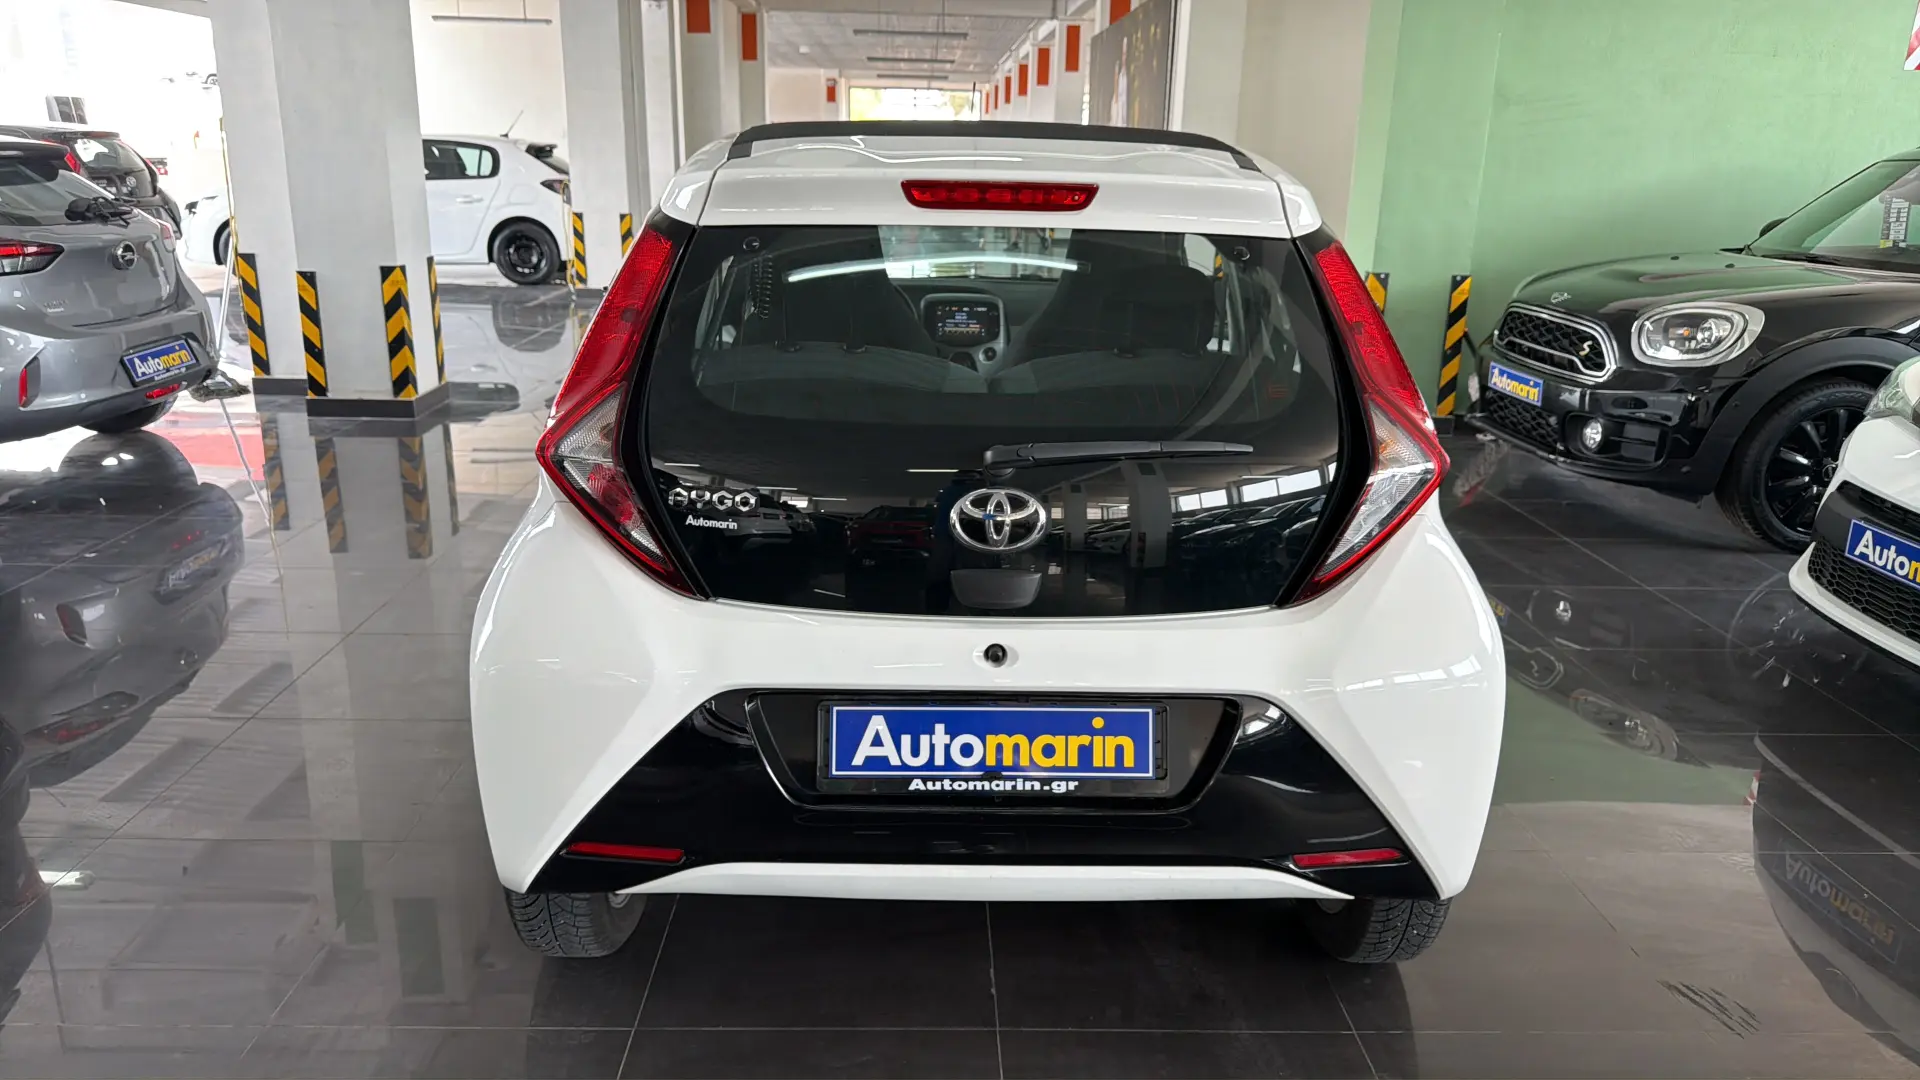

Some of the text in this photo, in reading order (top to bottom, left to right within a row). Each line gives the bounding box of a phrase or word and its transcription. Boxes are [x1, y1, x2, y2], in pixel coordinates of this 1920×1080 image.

[133, 345, 191, 377] Automarin
[1491, 367, 1540, 402] Automarin
[668, 487, 757, 512] AYGO
[685, 515, 738, 530] Automarin
[851, 715, 1135, 768] Automarin
[908, 778, 1079, 793] Automarin.gr
